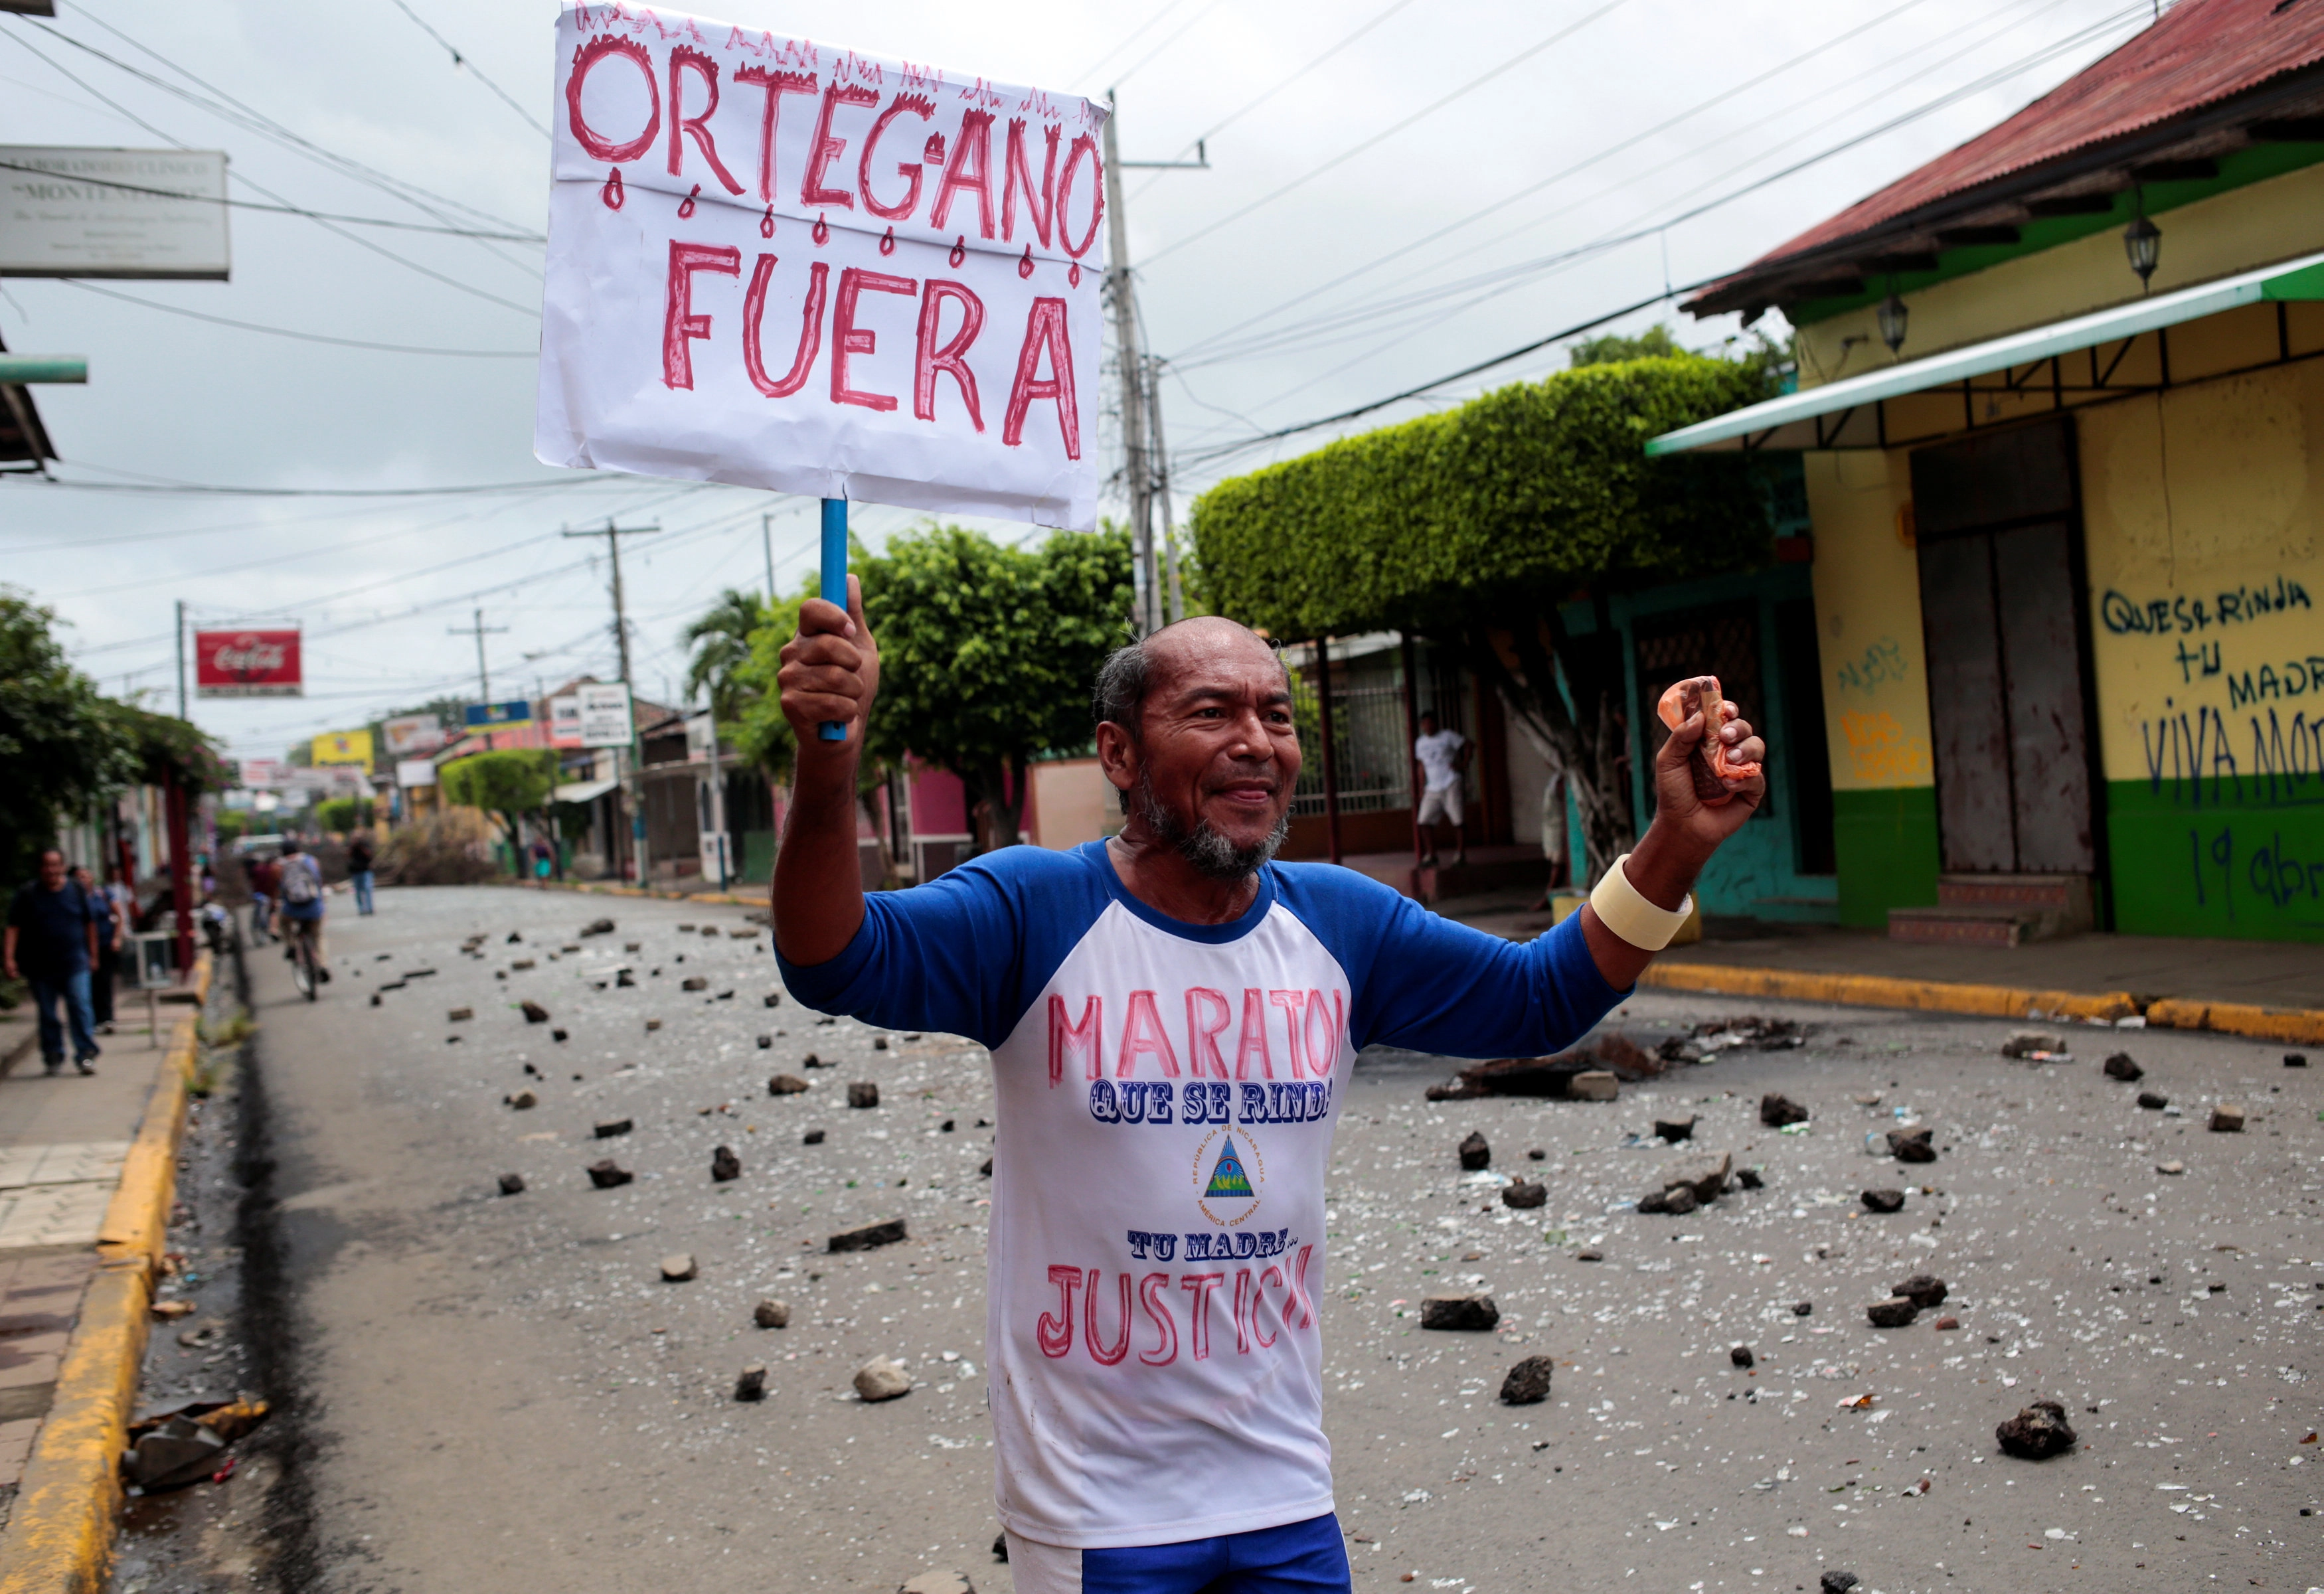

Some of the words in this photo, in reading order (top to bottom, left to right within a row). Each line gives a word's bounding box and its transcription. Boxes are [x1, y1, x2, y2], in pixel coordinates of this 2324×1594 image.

[659, 238, 1081, 462] FUERA
[2191, 827, 2236, 921] 19
[1089, 1078, 1174, 1125] QUE
[1181, 1081, 1232, 1125] SE
[1236, 1127, 1265, 1183] NICARAGUA
[1229, 1200, 1261, 1227] CENTRAL
[1127, 1230, 1178, 1261] TU
